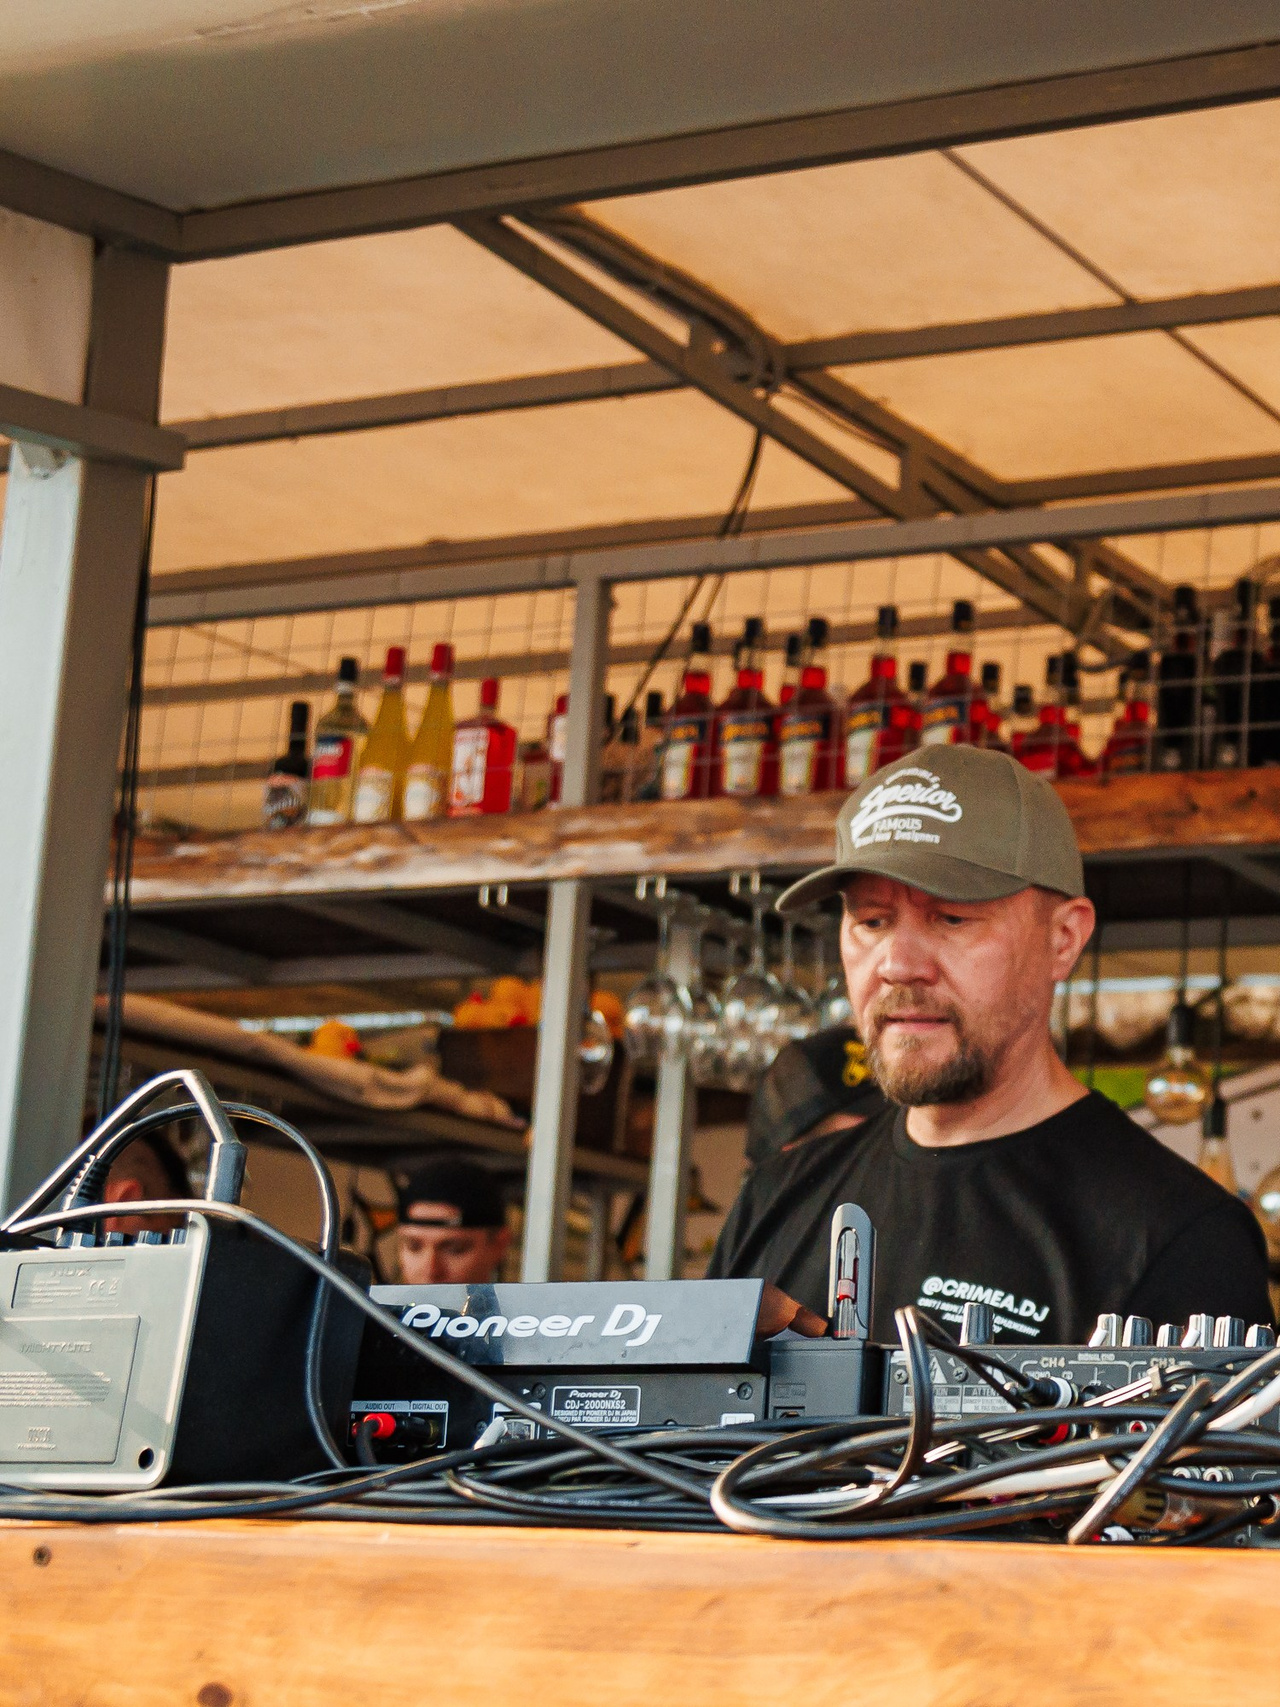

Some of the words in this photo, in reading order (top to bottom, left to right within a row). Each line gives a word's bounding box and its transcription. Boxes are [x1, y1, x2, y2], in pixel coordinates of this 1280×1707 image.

[922, 1276, 1050, 1322] @CRIMEA.DJ
[401, 1303, 596, 1338] Pioneer
[565, 1399, 626, 1410] CDJ-2000NXS2
[569, 1389, 609, 1398] Pioneer
